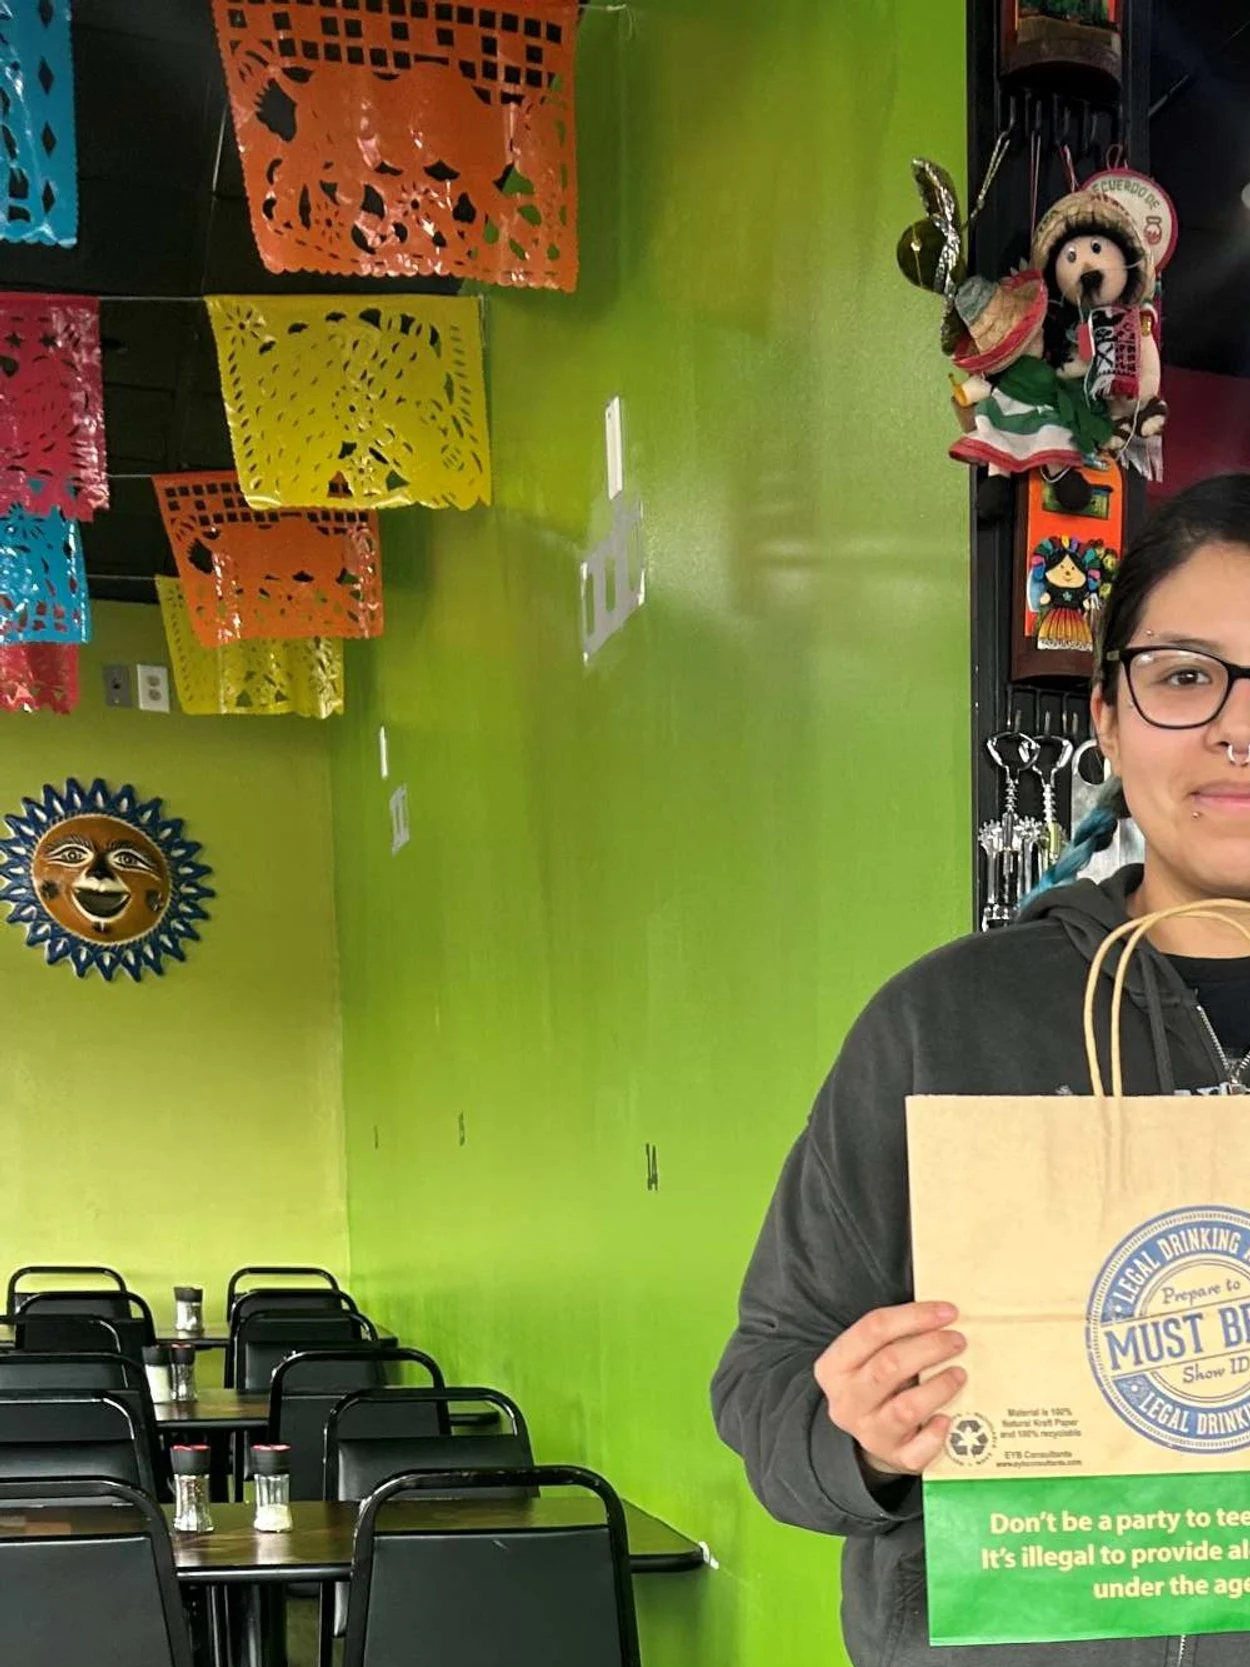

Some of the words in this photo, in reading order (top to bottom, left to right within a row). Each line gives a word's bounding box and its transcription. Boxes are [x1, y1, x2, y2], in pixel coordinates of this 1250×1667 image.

[1092, 178, 1147, 200] ECUERDO
[1113, 1251, 1161, 1305] LEGAL
[1157, 1226, 1241, 1260] DRINKING
[1162, 1284, 1221, 1306] Prepare
[1226, 1278, 1241, 1292] to
[1103, 1313, 1204, 1371] MUST
[1182, 1363, 1226, 1385] Show
[1138, 1391, 1190, 1433] LEGAL
[1062, 1510, 1092, 1532] be
[1098, 1514, 1112, 1531] a
[1116, 1510, 1181, 1536] party
[1185, 1508, 1211, 1528] to
[1021, 1543, 1095, 1572] illegal
[1100, 1546, 1126, 1565] to
[1131, 1539, 1223, 1569] provide
[1093, 1575, 1164, 1599] under
[1169, 1574, 1209, 1596] the
